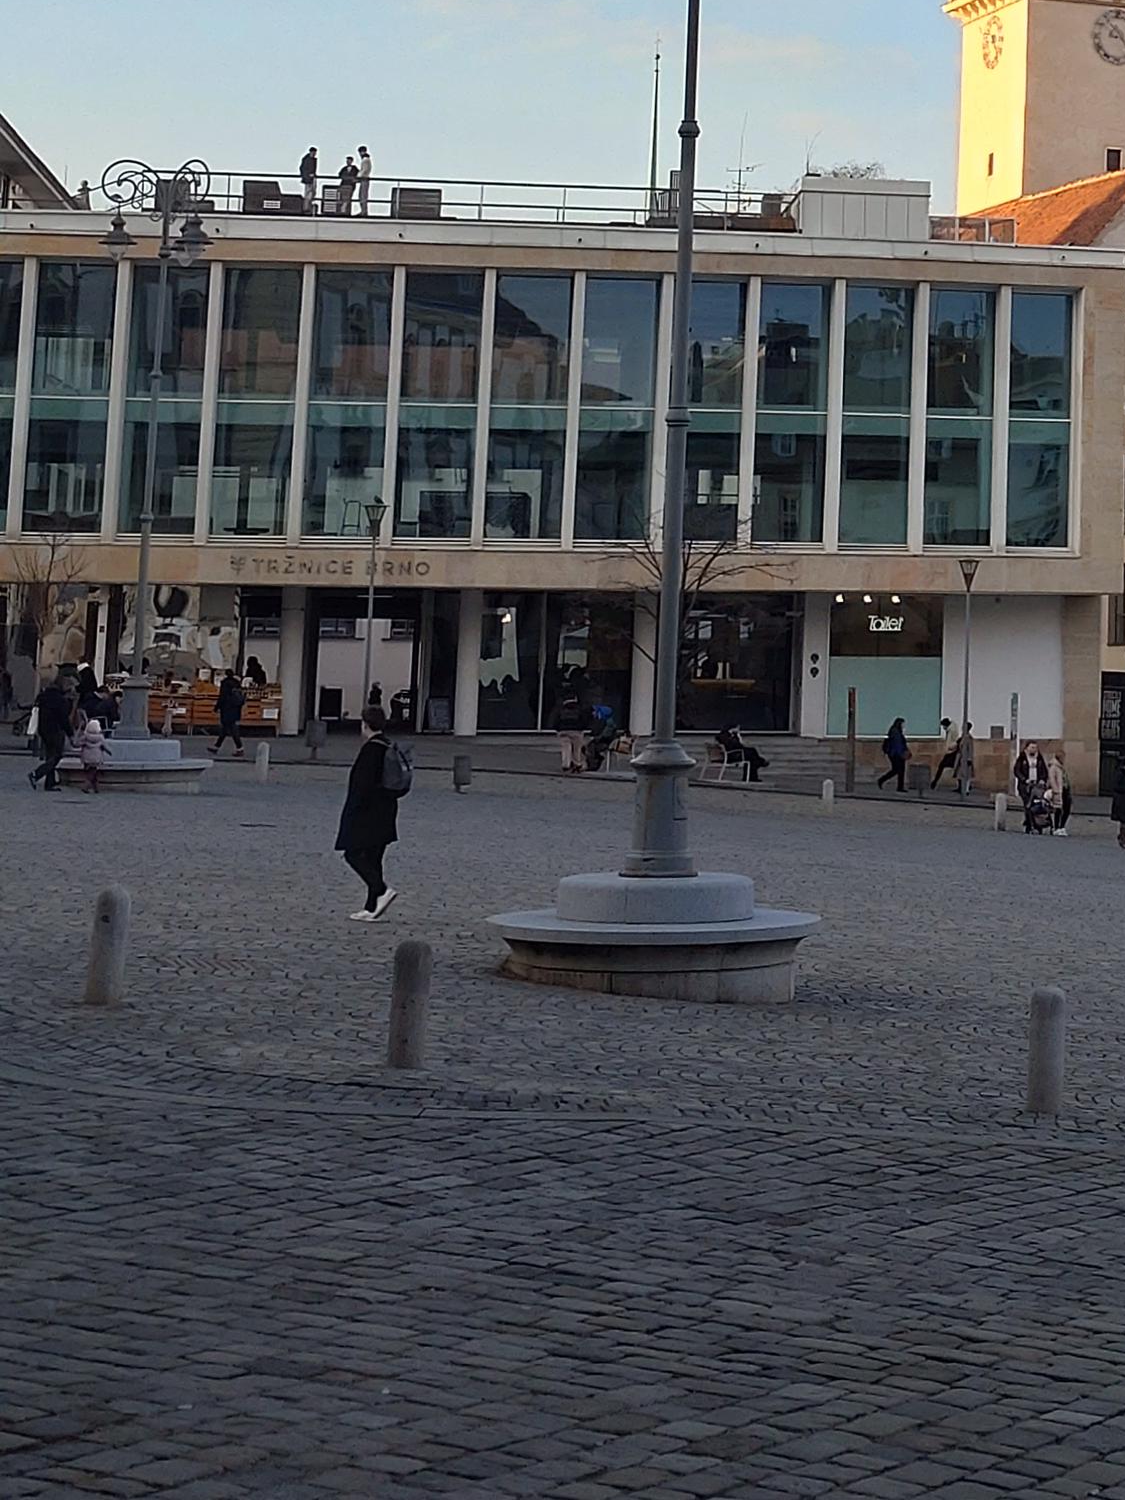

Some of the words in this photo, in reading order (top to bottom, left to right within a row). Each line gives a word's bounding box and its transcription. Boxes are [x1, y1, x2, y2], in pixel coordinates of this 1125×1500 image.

[252, 556, 354, 575] TRŽNICE
[366, 560, 430, 576] BRNO
[868, 615, 904, 631] Toilet
